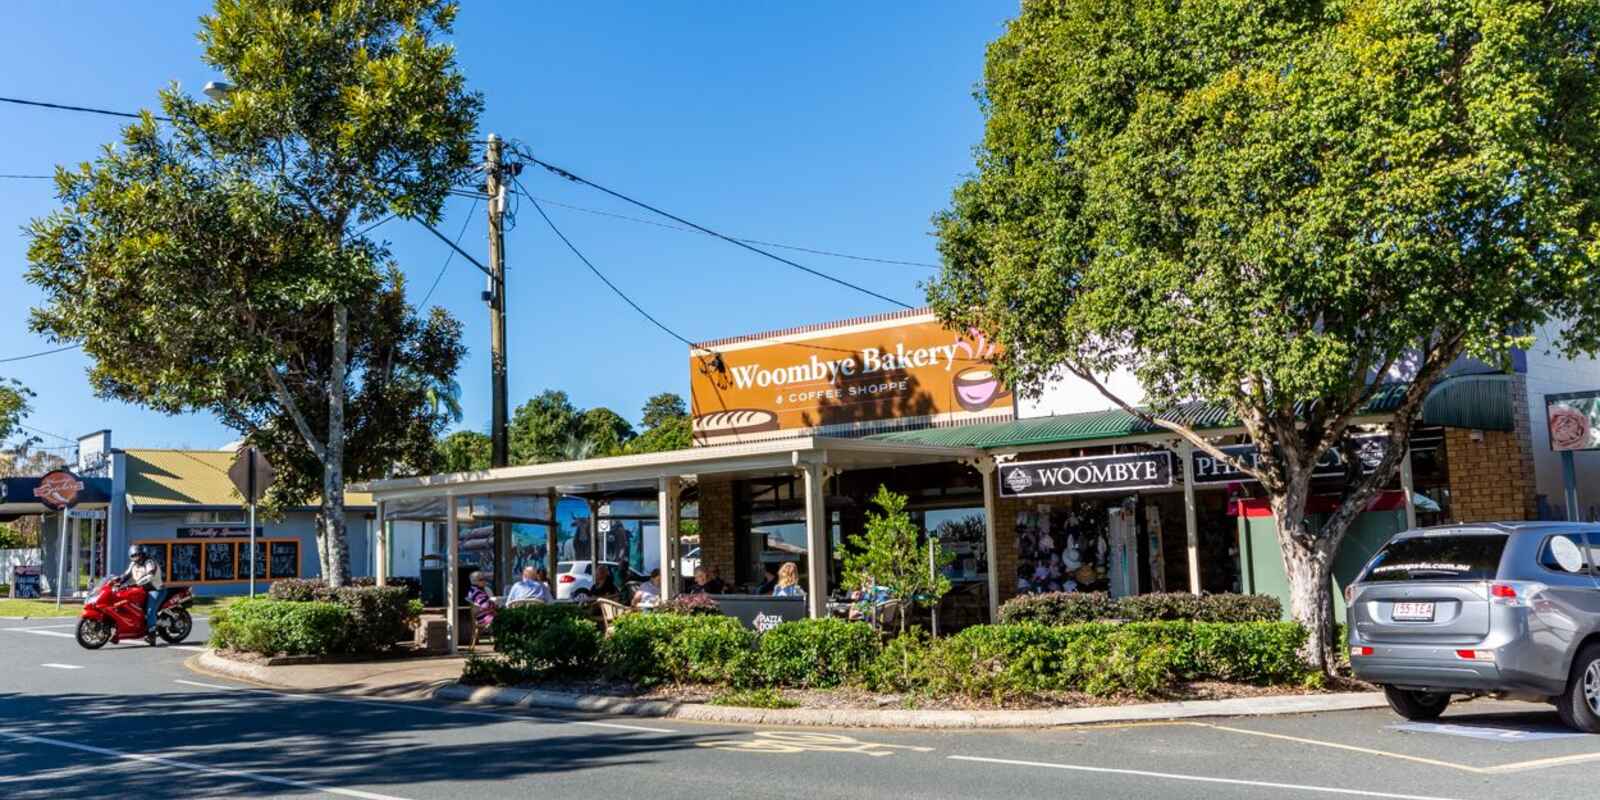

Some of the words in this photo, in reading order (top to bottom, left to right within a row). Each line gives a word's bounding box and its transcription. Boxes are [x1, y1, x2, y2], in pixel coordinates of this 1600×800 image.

[730, 354, 854, 389] Woombye
[862, 343, 957, 374] Bakery
[788, 389, 842, 402] COFFEE
[1038, 461, 1158, 486] WOOMBYE
[1196, 447, 1345, 476] PHAY
